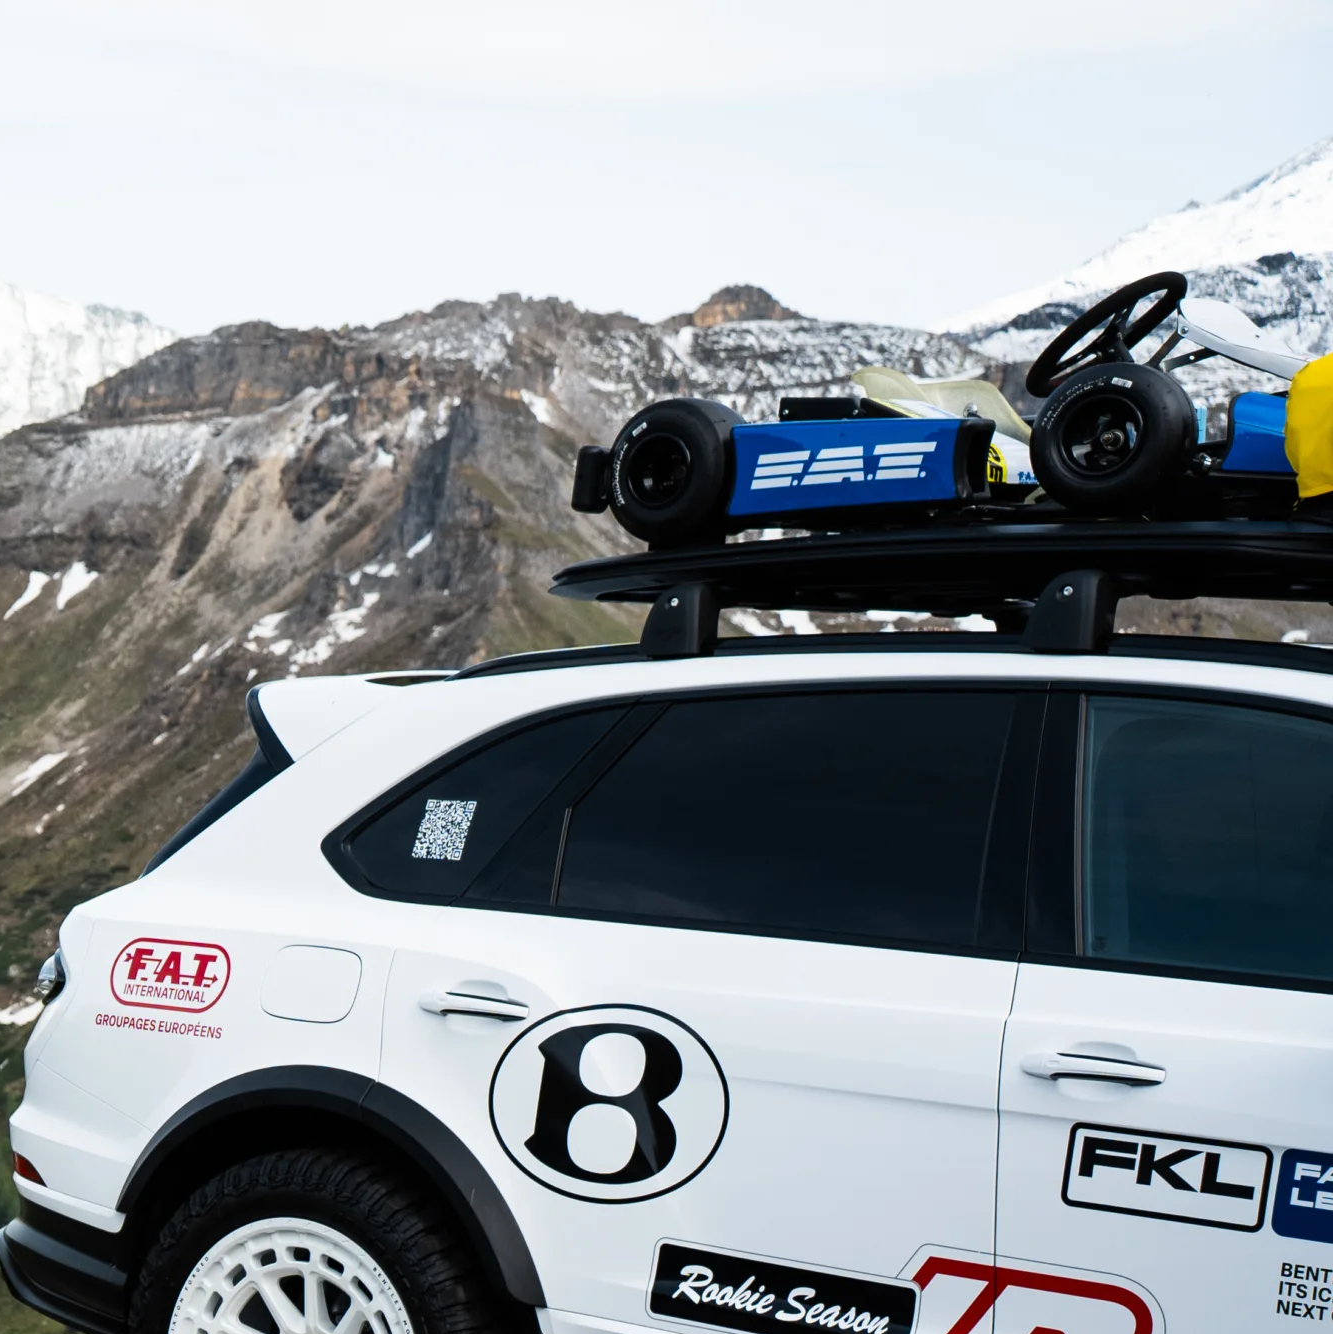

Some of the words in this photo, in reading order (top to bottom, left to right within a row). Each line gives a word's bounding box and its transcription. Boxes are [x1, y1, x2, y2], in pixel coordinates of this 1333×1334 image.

[123, 983, 206, 1003] INTERNATIONAL
[95, 1013, 157, 1031] GROUPAGES
[157, 1021, 223, 1039] EUROPÉENS
[1078, 1136, 1255, 1200] FKL
[1280, 1262, 1333, 1284] BENT
[372, 1266, 403, 1312] BENTLEY
[671, 1264, 776, 1315] Rookie
[1278, 1280, 1308, 1299] ITS
[1312, 1286, 1333, 1303] IC
[1276, 1299, 1329, 1321] NEXT
